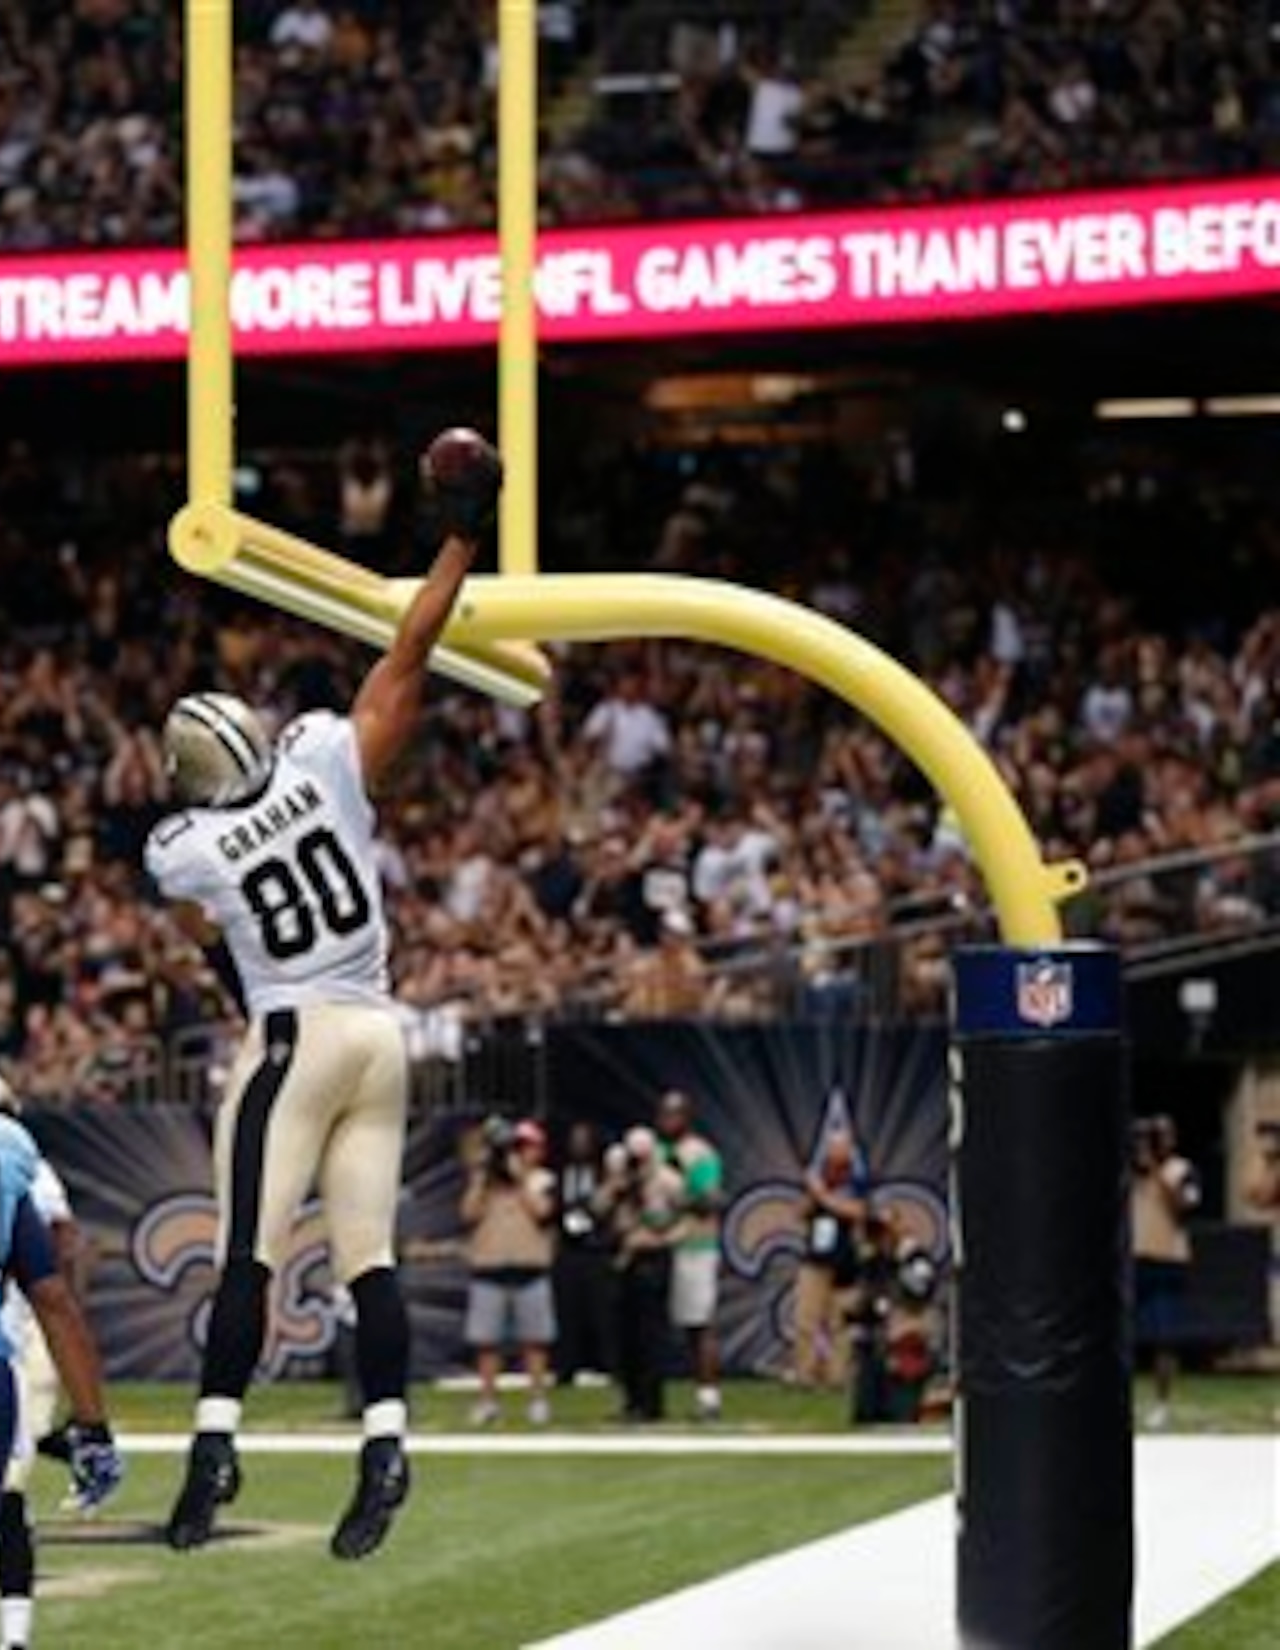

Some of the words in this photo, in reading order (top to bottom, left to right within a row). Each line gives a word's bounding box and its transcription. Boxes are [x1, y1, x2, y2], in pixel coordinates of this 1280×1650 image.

[379, 257, 501, 325] LIVE
[635, 240, 837, 308] GAMES
[841, 231, 997, 298] THAN
[1004, 216, 1146, 287] EVER
[216, 781, 323, 861] GRAHAM
[241, 828, 370, 960] 80
